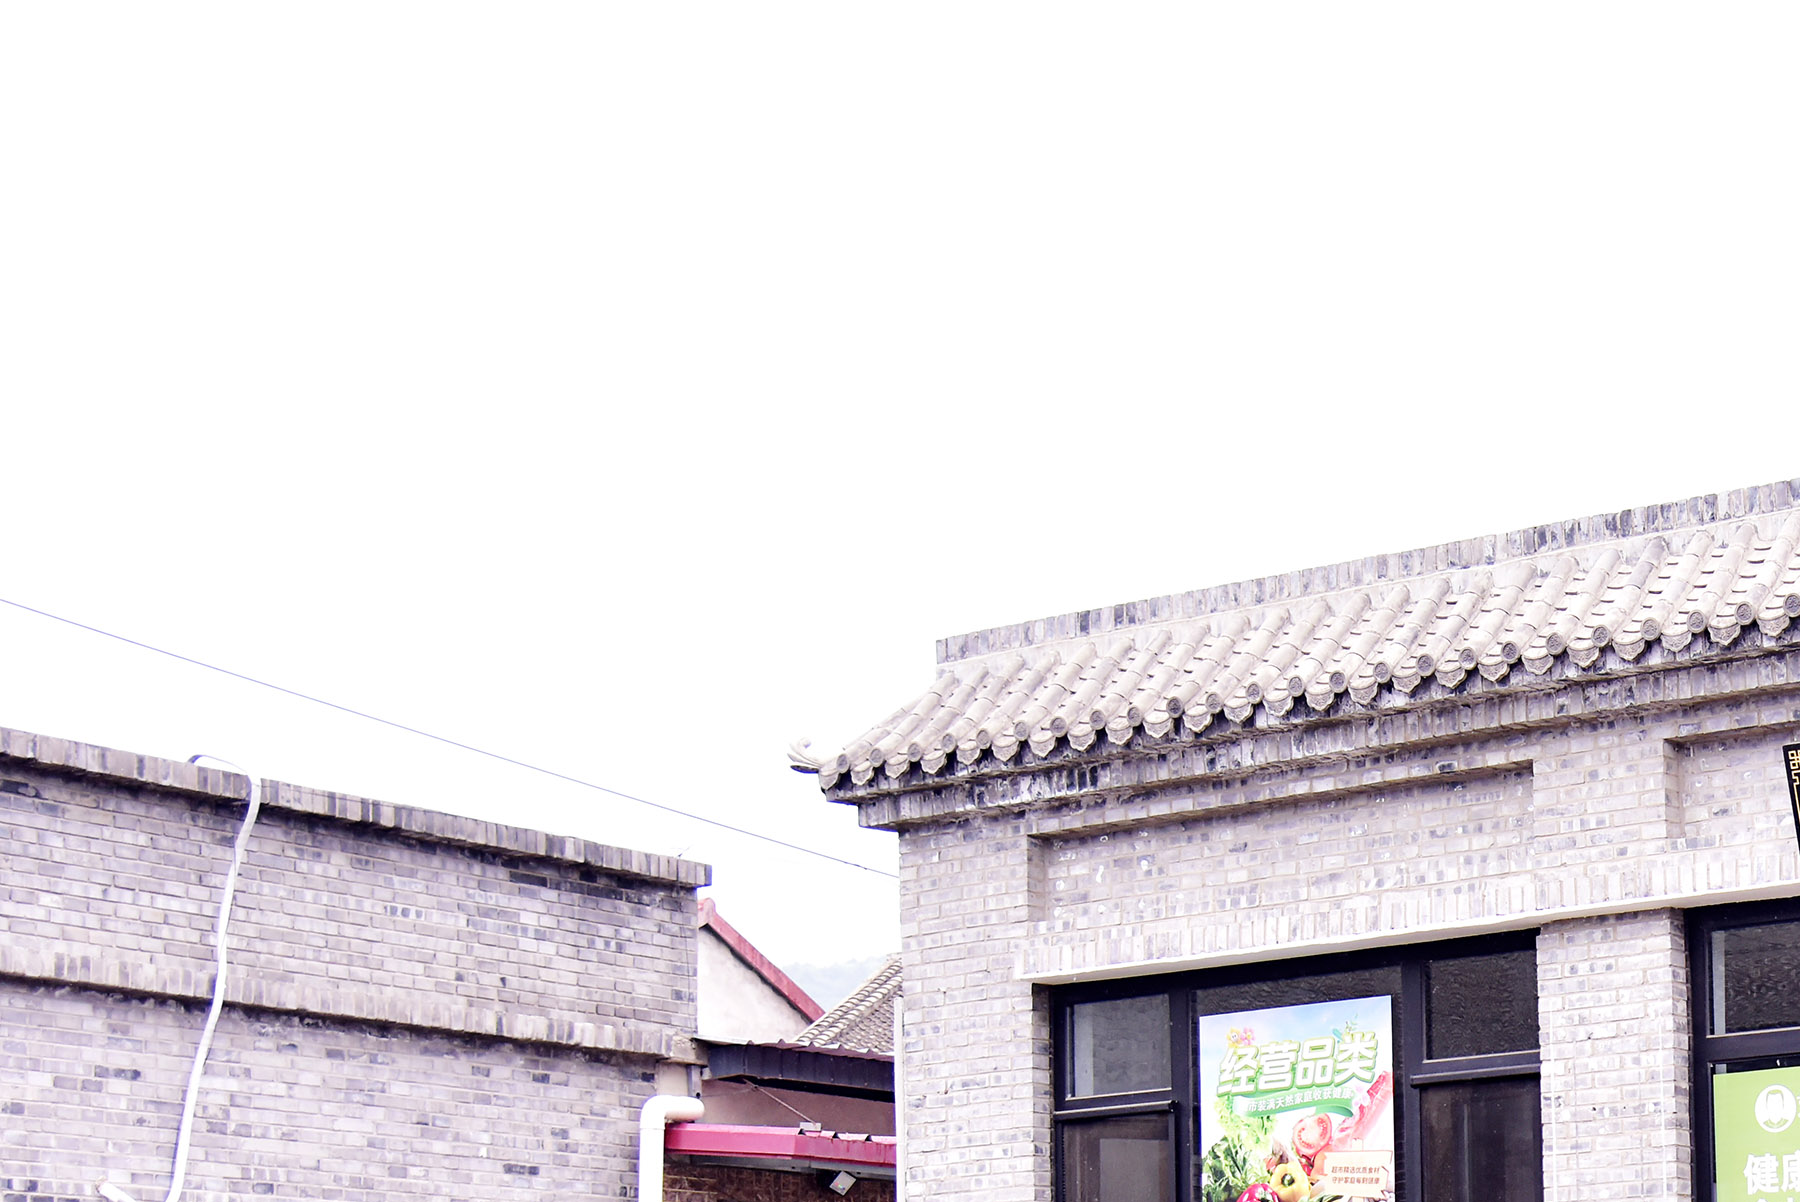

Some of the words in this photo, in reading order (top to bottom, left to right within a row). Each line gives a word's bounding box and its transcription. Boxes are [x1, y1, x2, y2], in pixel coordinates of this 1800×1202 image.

[1216, 1031, 1378, 1097] 经营品类
[1241, 1086, 1354, 1113] 市装满天然家庭收获健康
